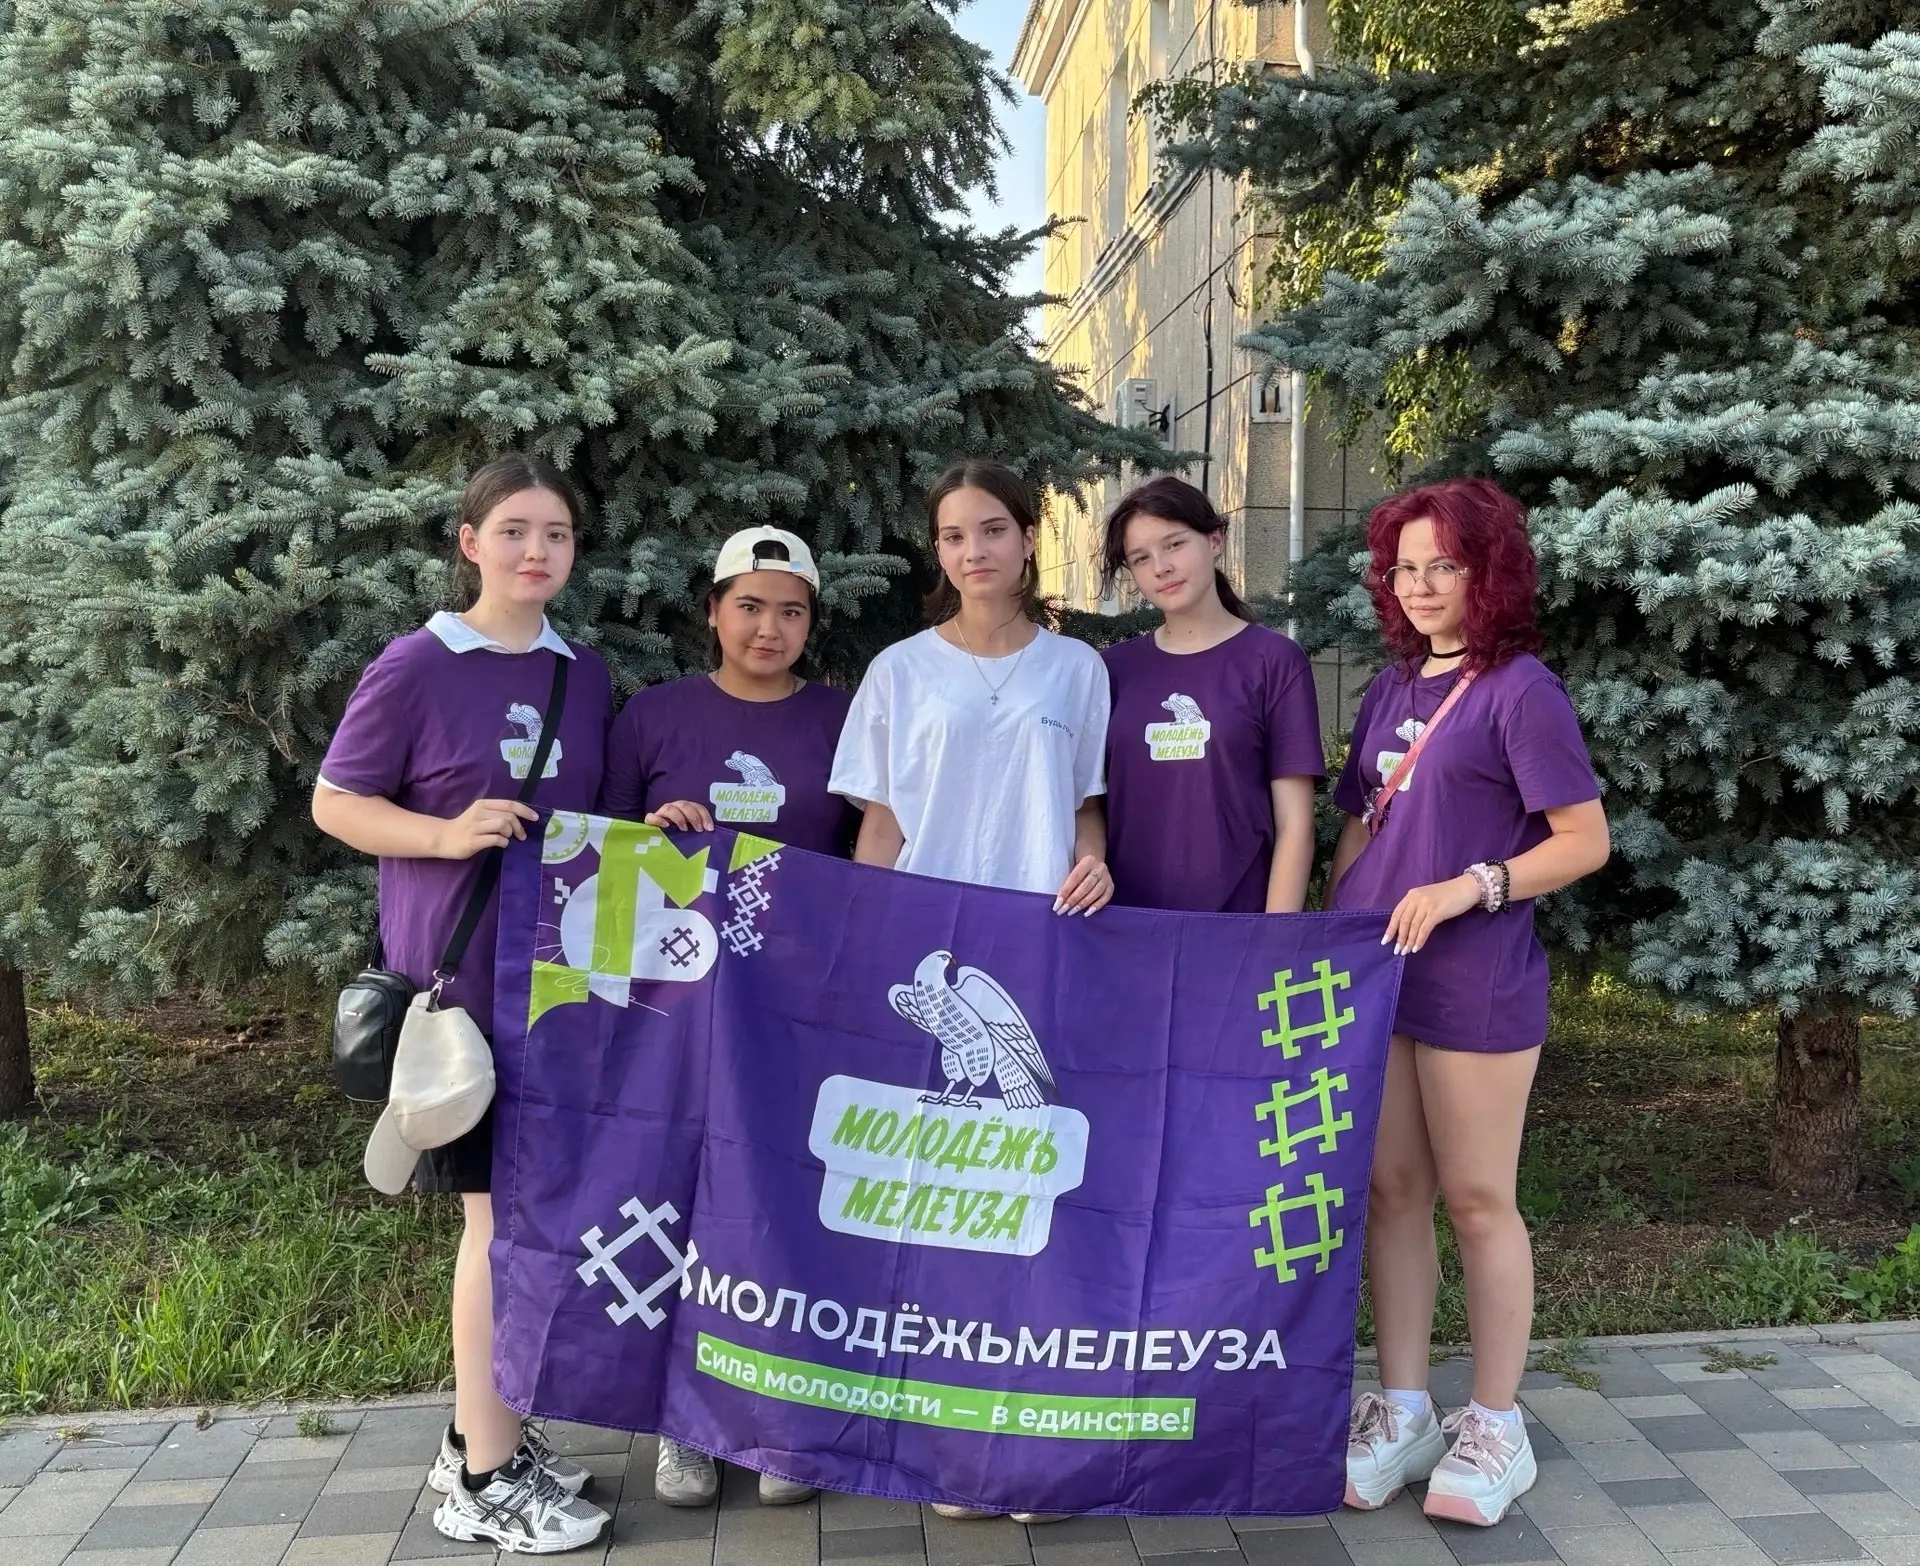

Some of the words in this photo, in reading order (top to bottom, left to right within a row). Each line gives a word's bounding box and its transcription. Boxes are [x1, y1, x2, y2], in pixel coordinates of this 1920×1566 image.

[1041, 716, 1062, 729] Будь
[1156, 744, 1200, 758] МЕЛЕУЗА
[721, 807, 771, 820] МЕЛЕУЗА
[830, 1103, 1059, 1176] МОЛОДЁЖЬ
[840, 1176, 1031, 1241] МЕЛЕУЗА
[697, 1342, 758, 1385] Сила
[764, 1368, 942, 1419] молодости
[991, 1405, 1009, 1425] в
[1018, 1406, 1191, 1433] единстве!
